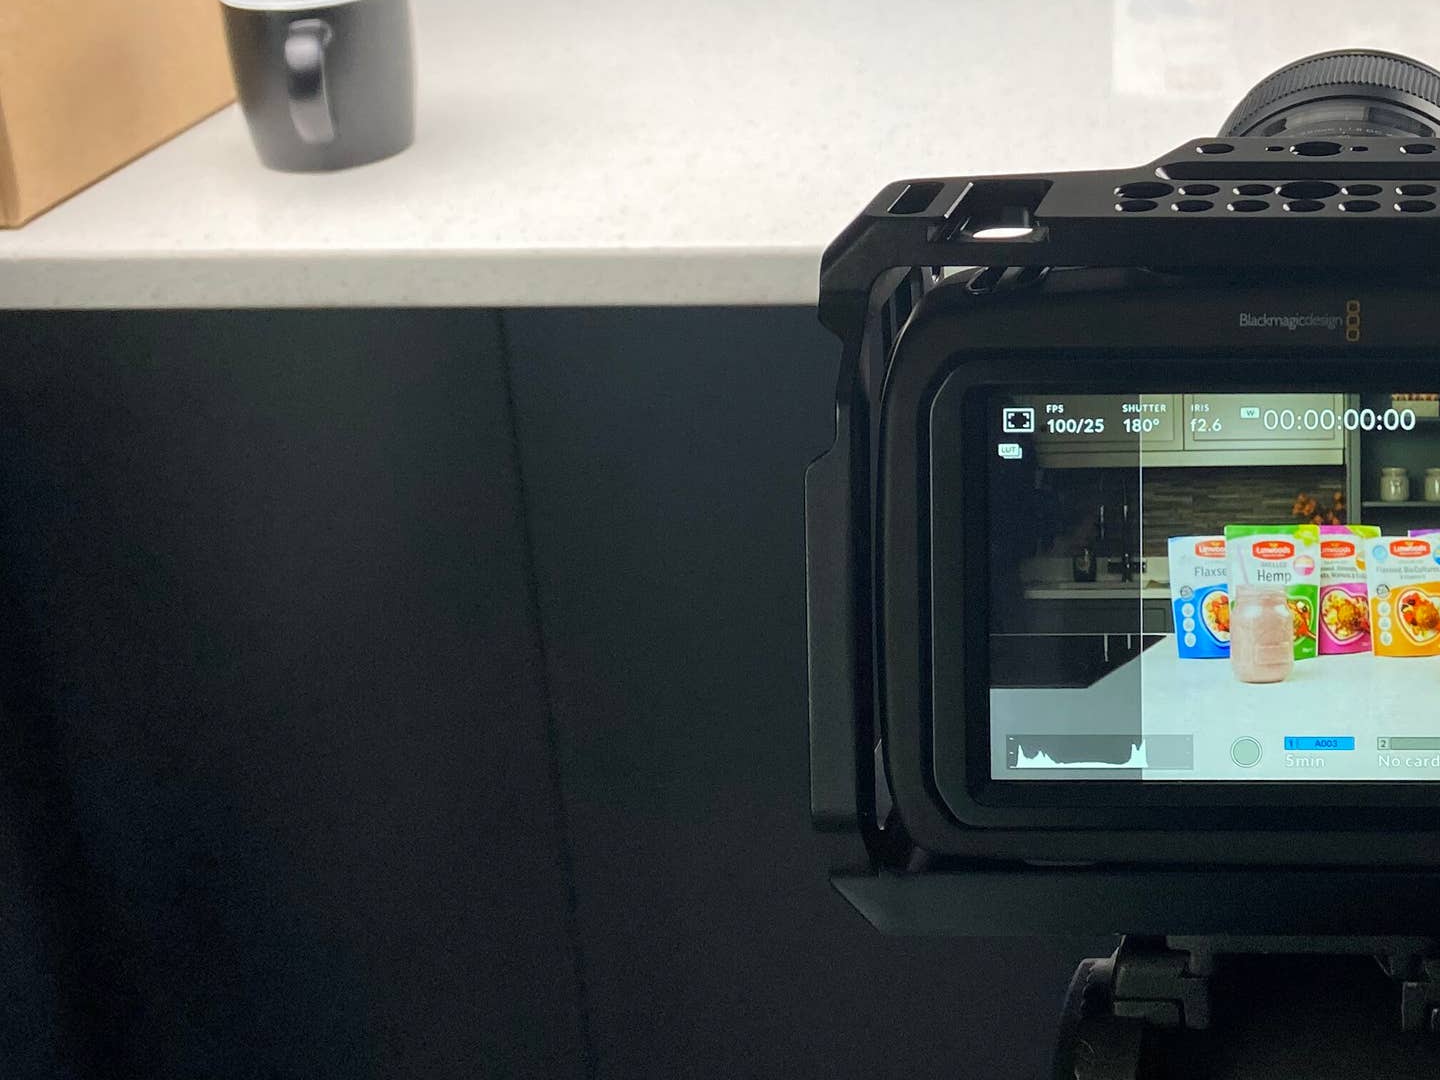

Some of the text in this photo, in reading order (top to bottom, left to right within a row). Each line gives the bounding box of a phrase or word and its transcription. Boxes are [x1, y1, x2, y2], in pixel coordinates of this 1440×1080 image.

[1046, 404, 1064, 413] FPS
[1122, 404, 1167, 413] SHUTTER
[1191, 404, 1210, 412] IRIS
[1123, 418, 1160, 433] 180°
[1190, 418, 1222, 432] f2.6
[1263, 408, 1416, 431] 00:00:00:00
[1047, 418, 1105, 434] 100/25
[1001, 446, 1017, 454] LUT
[1257, 569, 1292, 584] Hemp
[1314, 739, 1338, 748] A003
[1285, 754, 1325, 767] 5min
[1378, 755, 1440, 767] No card
